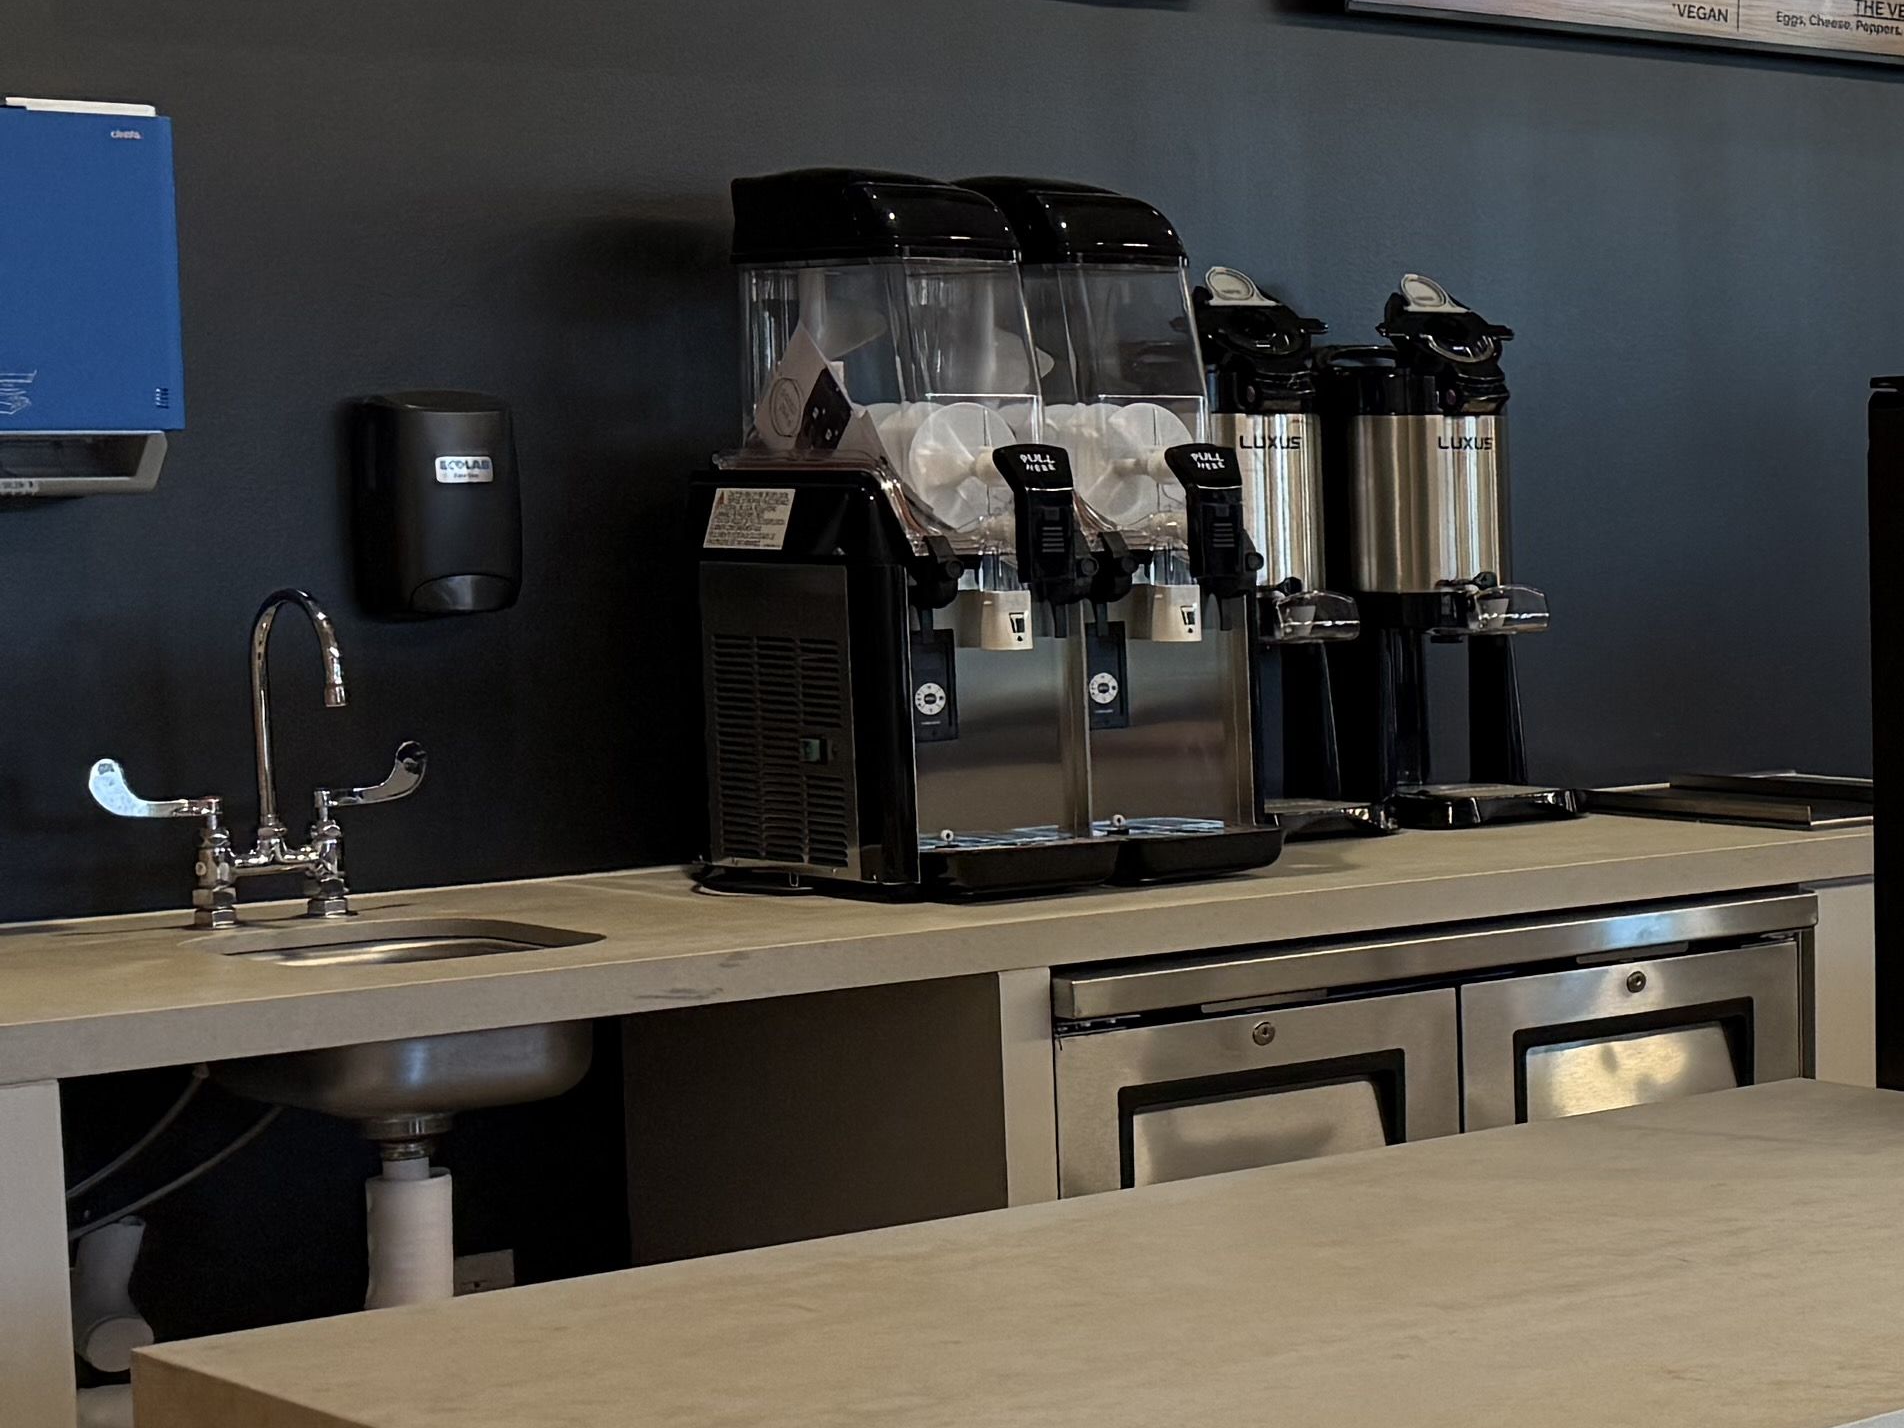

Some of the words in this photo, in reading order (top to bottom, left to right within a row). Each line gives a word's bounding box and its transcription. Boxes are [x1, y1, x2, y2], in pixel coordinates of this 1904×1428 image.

[1854, 0, 1887, 17] THE
[1239, 435, 1301, 450] LUXUS
[1437, 436, 1493, 450] LUXUS
[1019, 453, 1055, 465] PULL
[1190, 452, 1225, 462] PULL
[440, 460, 490, 470] ECOLAB
